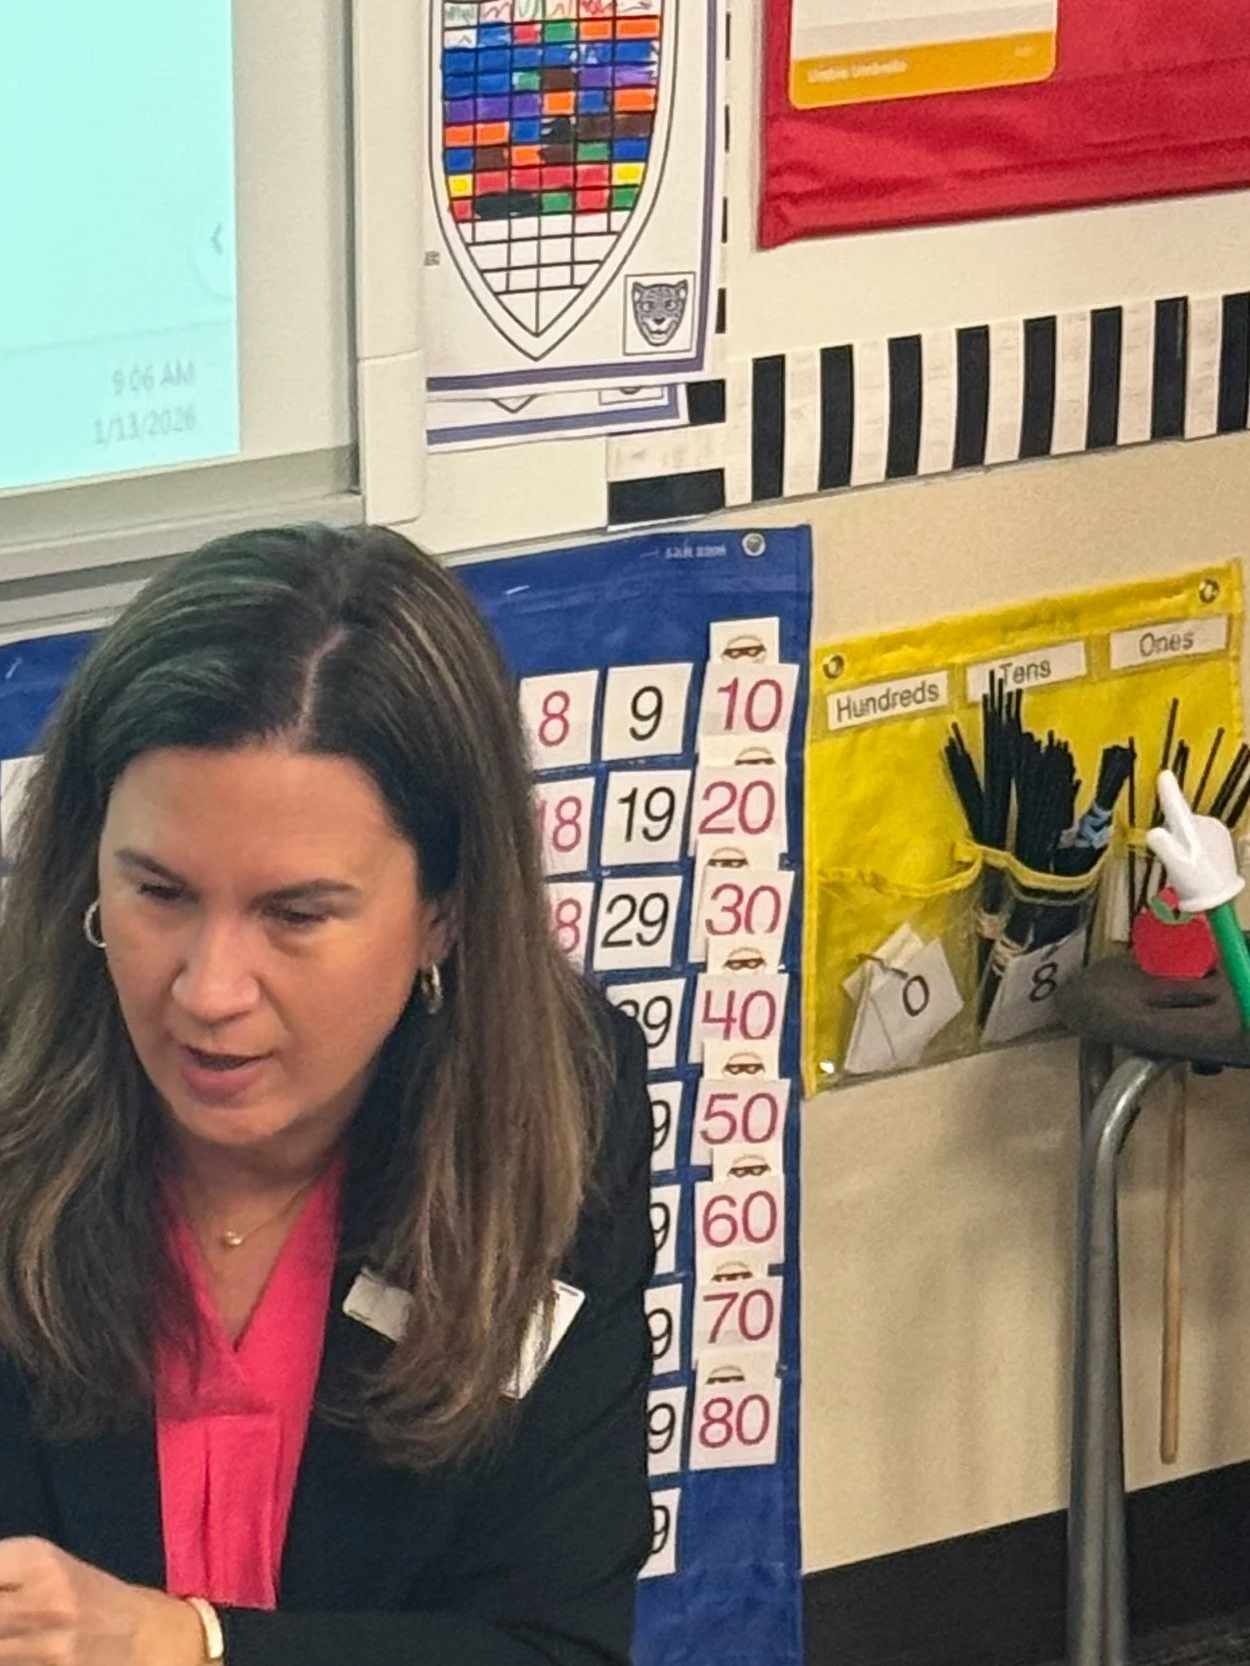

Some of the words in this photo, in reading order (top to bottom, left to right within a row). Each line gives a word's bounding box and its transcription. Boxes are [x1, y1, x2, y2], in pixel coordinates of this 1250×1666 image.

[999, 659, 1052, 686] Tens
[1139, 631, 1195, 658] Ones
[537, 690, 571, 748] 8
[630, 685, 664, 742] 9
[717, 677, 783, 733] 10
[835, 681, 941, 722] Hundreds
[617, 786, 676, 843] 19
[699, 780, 776, 835] 20
[554, 898, 583, 954] 8
[600, 892, 670, 948] 29
[705, 883, 782, 937] 30
[902, 975, 930, 1017] 0
[1028, 961, 1058, 1002] 8
[701, 989, 777, 1041] 40
[650, 1100, 671, 1152] 9
[700, 1092, 779, 1145] 50
[649, 1202, 671, 1252] 9
[701, 1190, 778, 1249] 60
[646, 1307, 673, 1360] 9
[701, 1288, 775, 1345] 70
[648, 1402, 677, 1454] 9
[697, 1393, 771, 1448] 80
